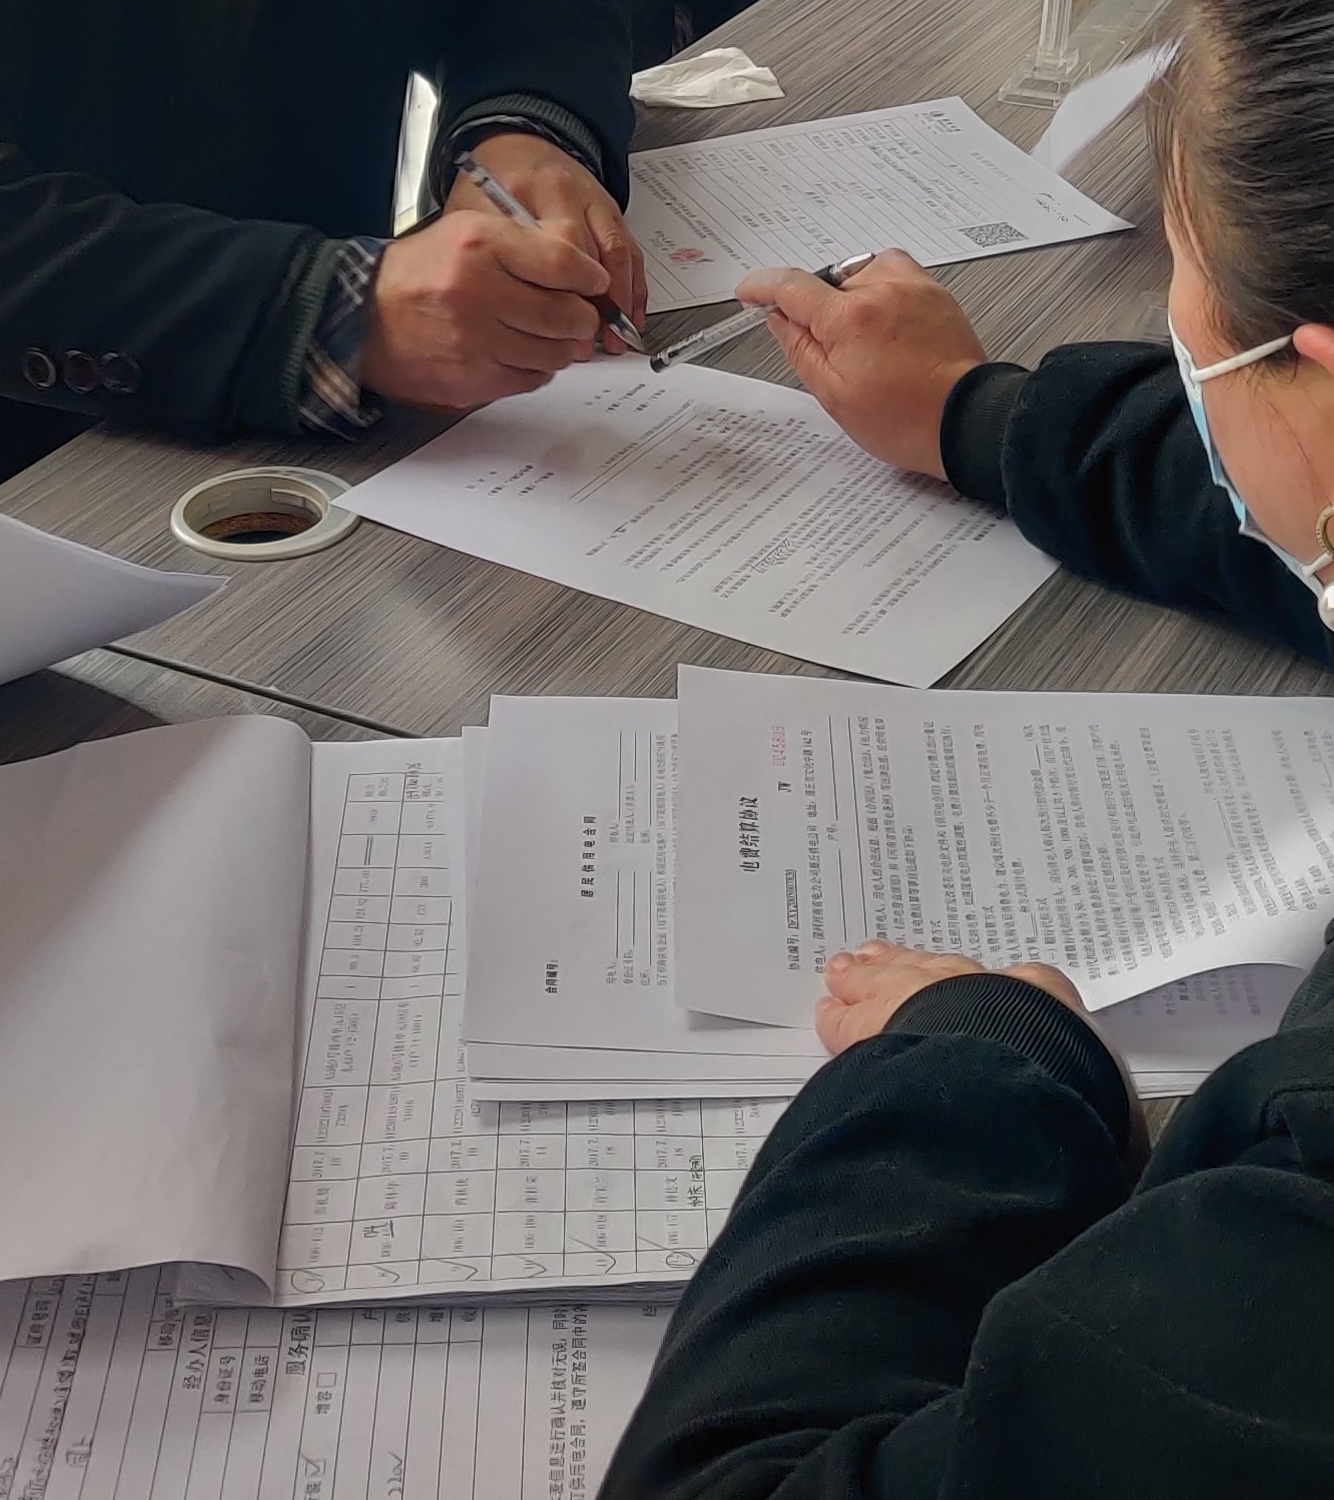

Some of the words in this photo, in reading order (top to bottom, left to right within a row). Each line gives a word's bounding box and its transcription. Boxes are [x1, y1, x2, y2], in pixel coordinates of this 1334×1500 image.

[182, 1311, 213, 1390] 经办人信息
